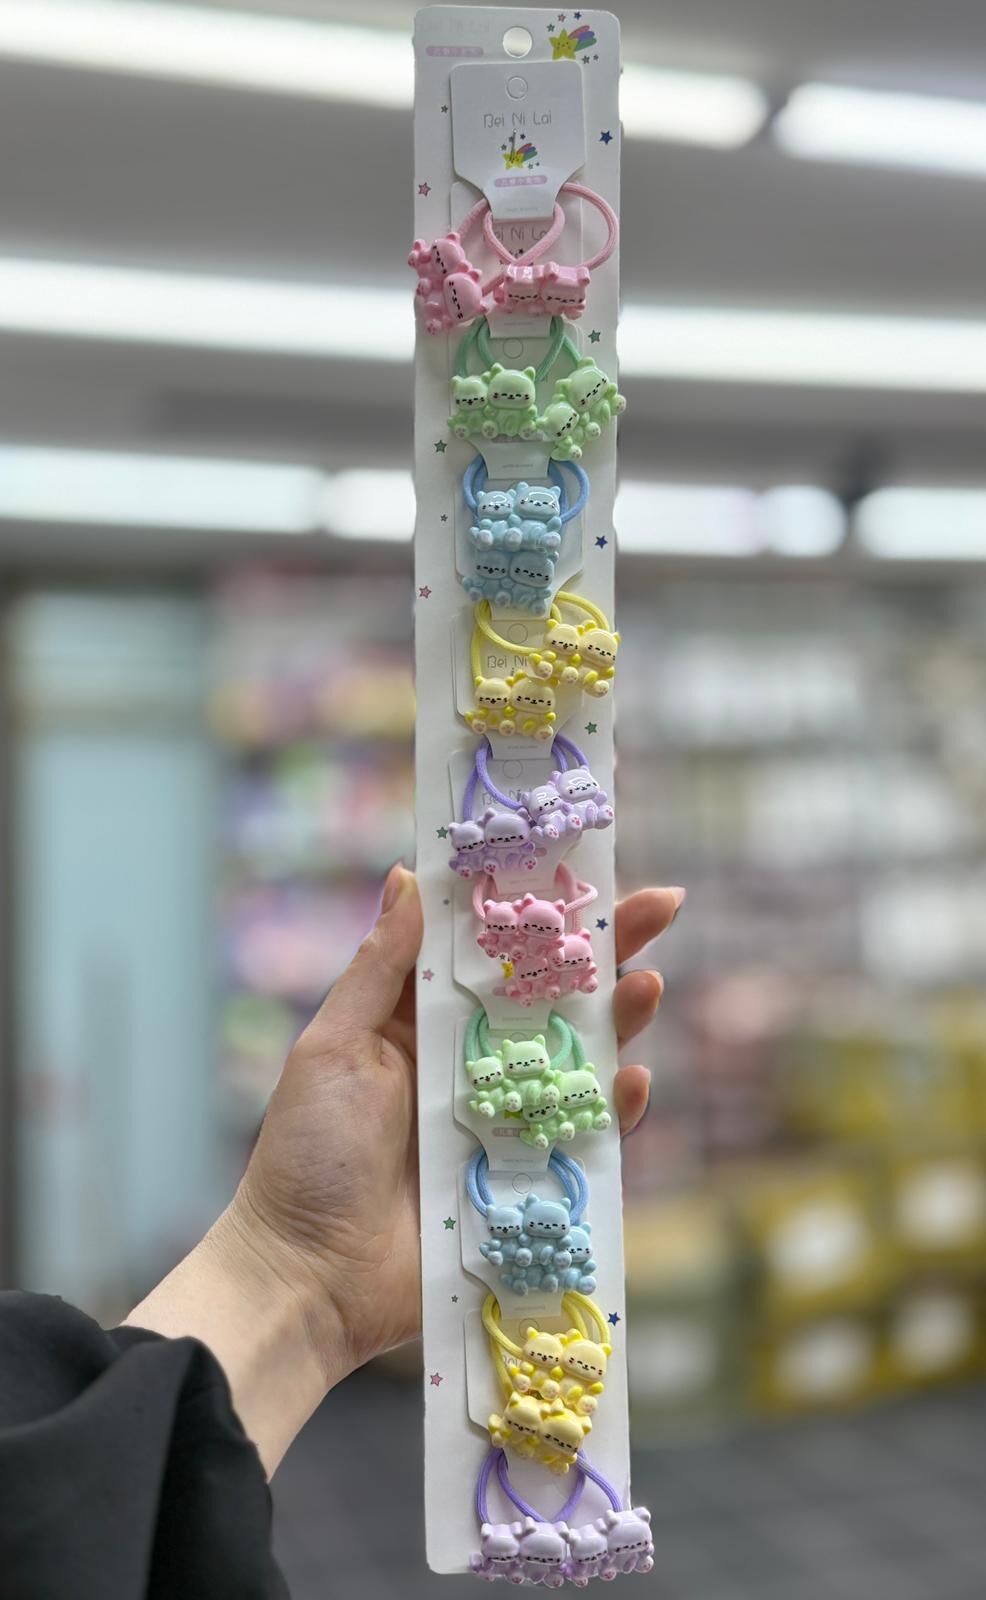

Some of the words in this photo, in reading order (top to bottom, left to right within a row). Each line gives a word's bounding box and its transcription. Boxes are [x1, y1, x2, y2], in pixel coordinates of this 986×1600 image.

[483, 112, 505, 128] Bei
[511, 111, 526, 126] Ni
[533, 109, 552, 126] Lai
[510, 226, 525, 241] Ni
[487, 655, 508, 668] Bei
[514, 655, 528, 667] Ni
